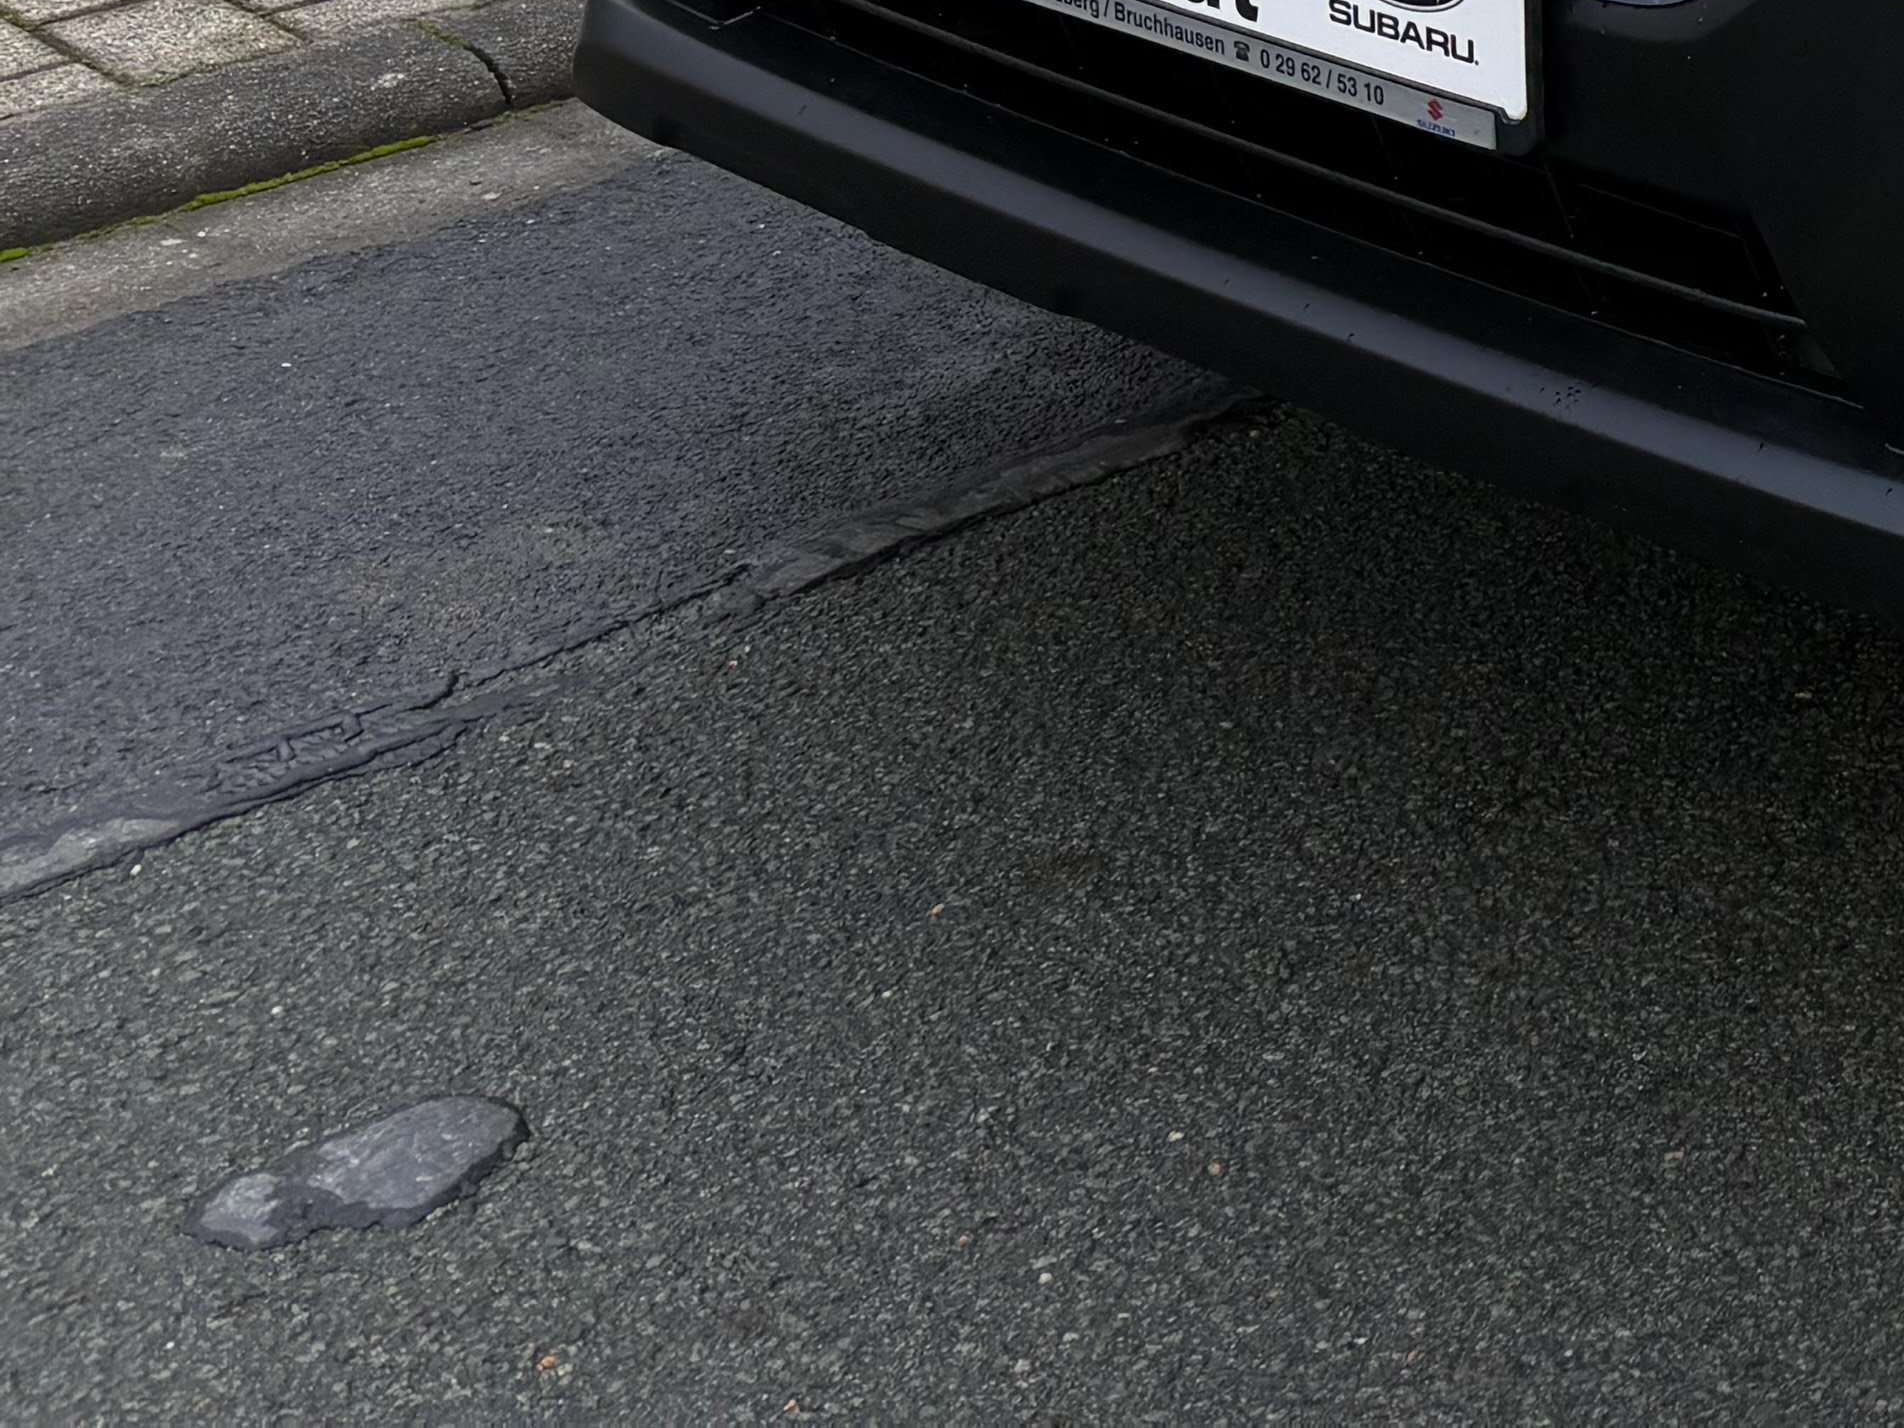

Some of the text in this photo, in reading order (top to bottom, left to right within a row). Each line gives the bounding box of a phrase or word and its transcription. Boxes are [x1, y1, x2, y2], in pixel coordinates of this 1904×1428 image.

[1114, 1, 1226, 55] Bruchhausen
[1260, 49, 1271, 69] 0
[1275, 54, 1296, 77] 29
[1301, 62, 1322, 85] 62
[1337, 73, 1357, 96] 53
[1364, 82, 1385, 106] 10
